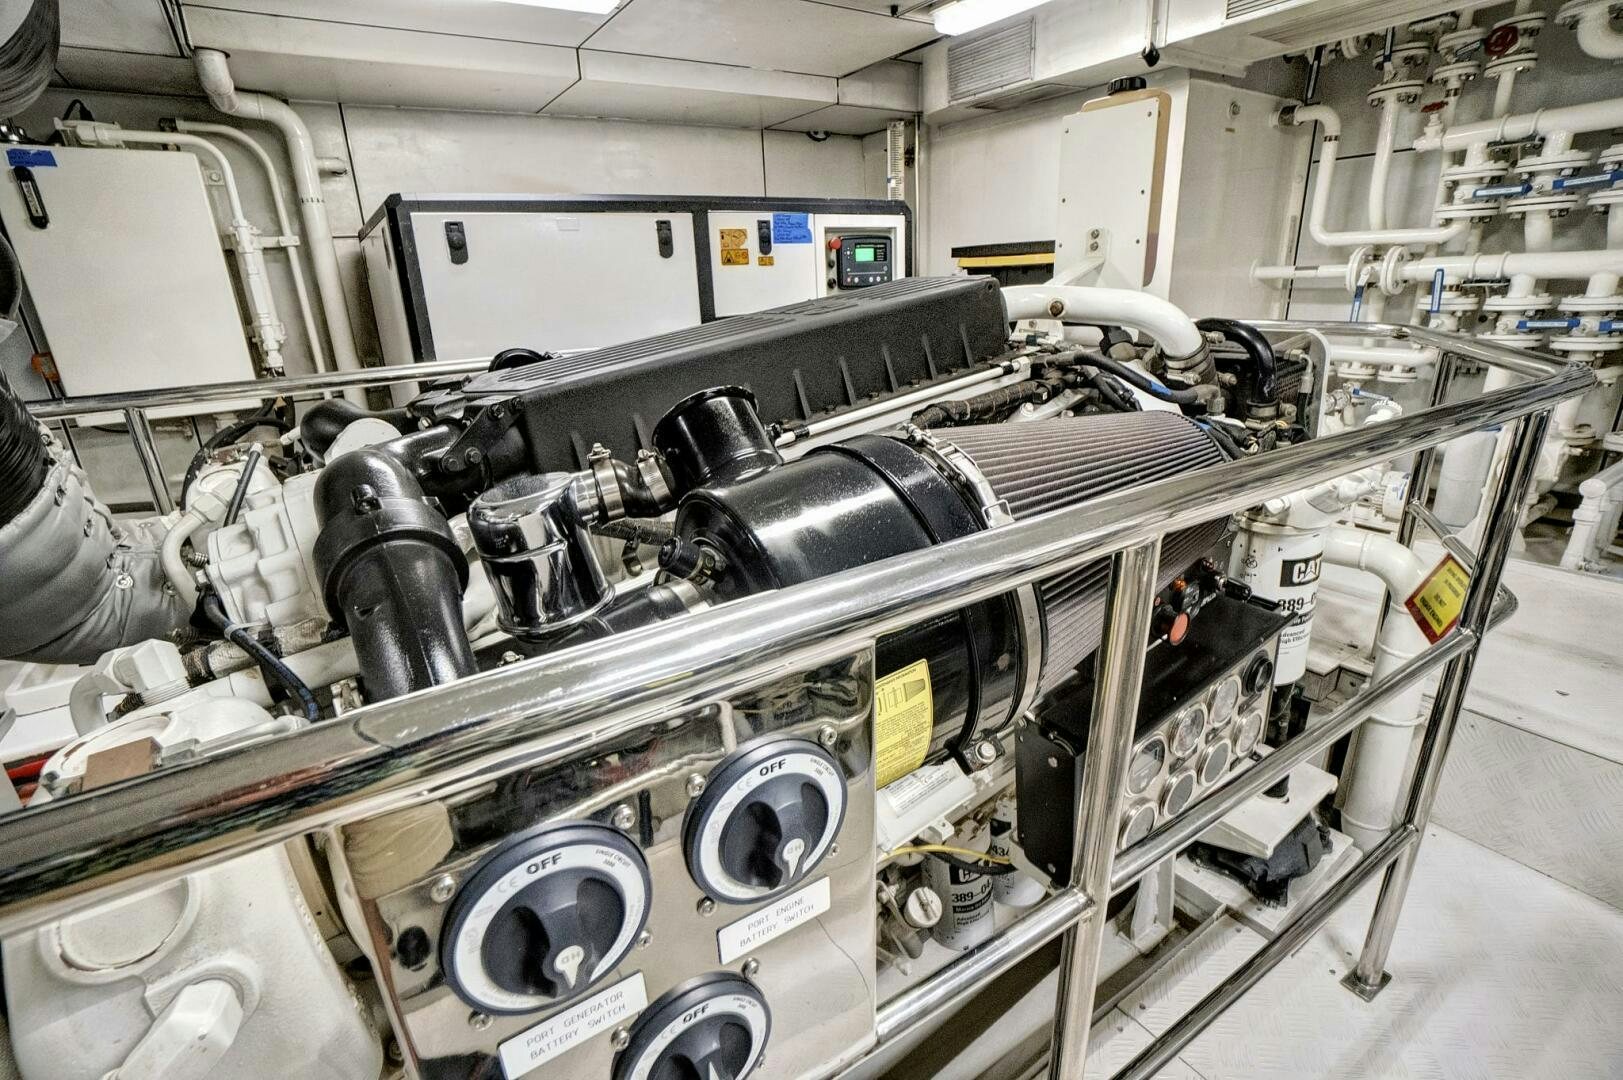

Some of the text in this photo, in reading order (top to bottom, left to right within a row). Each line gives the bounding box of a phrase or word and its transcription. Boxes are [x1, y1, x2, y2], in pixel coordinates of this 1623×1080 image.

[759, 758, 787, 777] OFF
[526, 852, 563, 875] OFF
[739, 903, 814, 948] BATTERY SWITCH
[748, 896, 805, 931] PORT ENGINE
[526, 991, 624, 1048] PORT GENERATOR
[682, 1003, 709, 1025] OFF
[530, 1003, 627, 1061] BATTERY SWITCH
